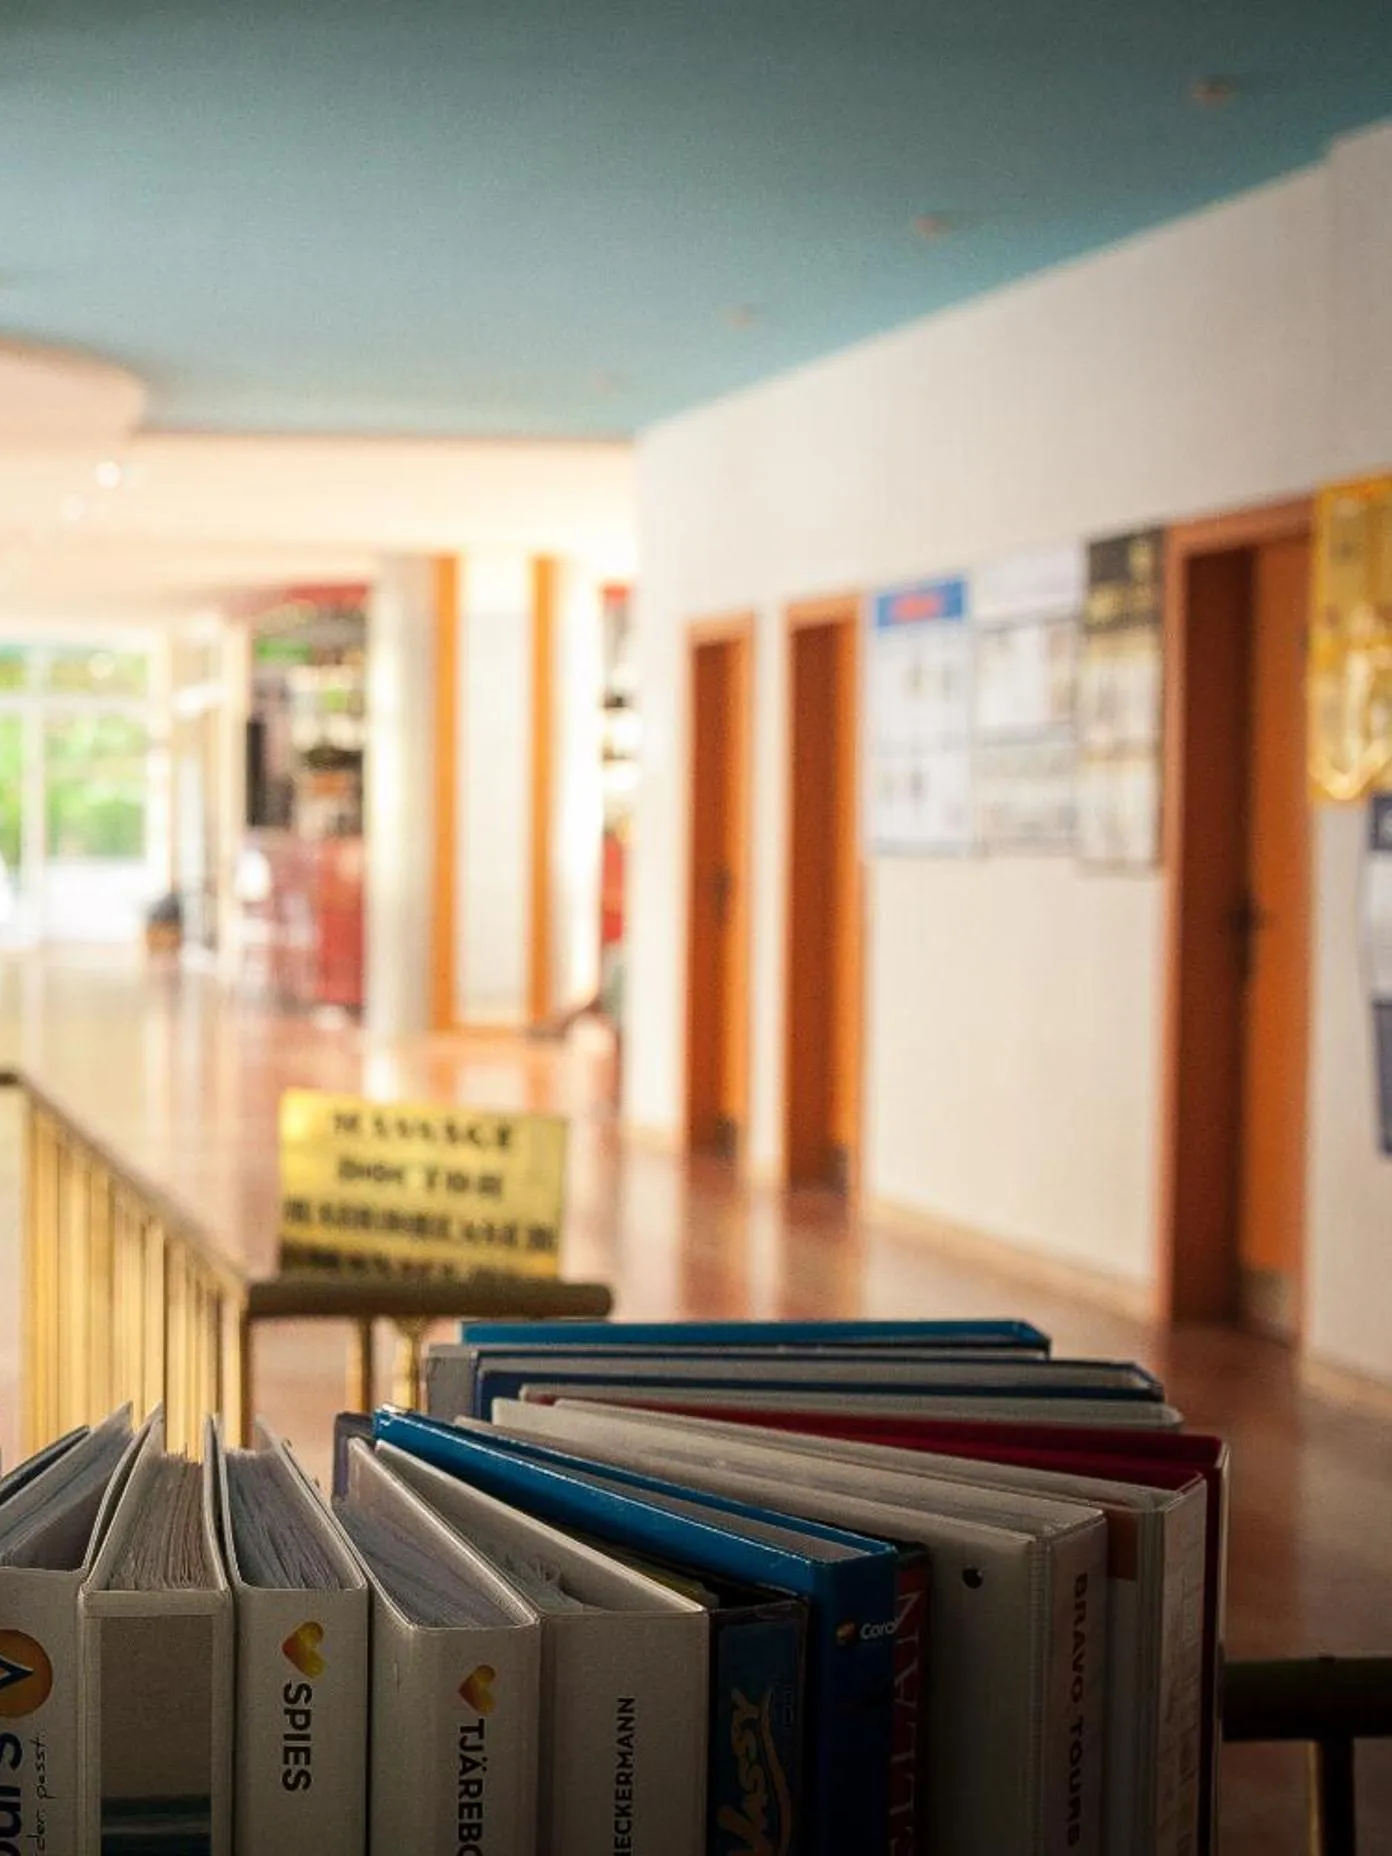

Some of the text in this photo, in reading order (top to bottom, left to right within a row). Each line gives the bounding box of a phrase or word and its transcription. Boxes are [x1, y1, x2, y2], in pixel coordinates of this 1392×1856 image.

[281, 1680, 313, 1792] SPIES
[1066, 1572, 1090, 1848] BRAVO TOURS
